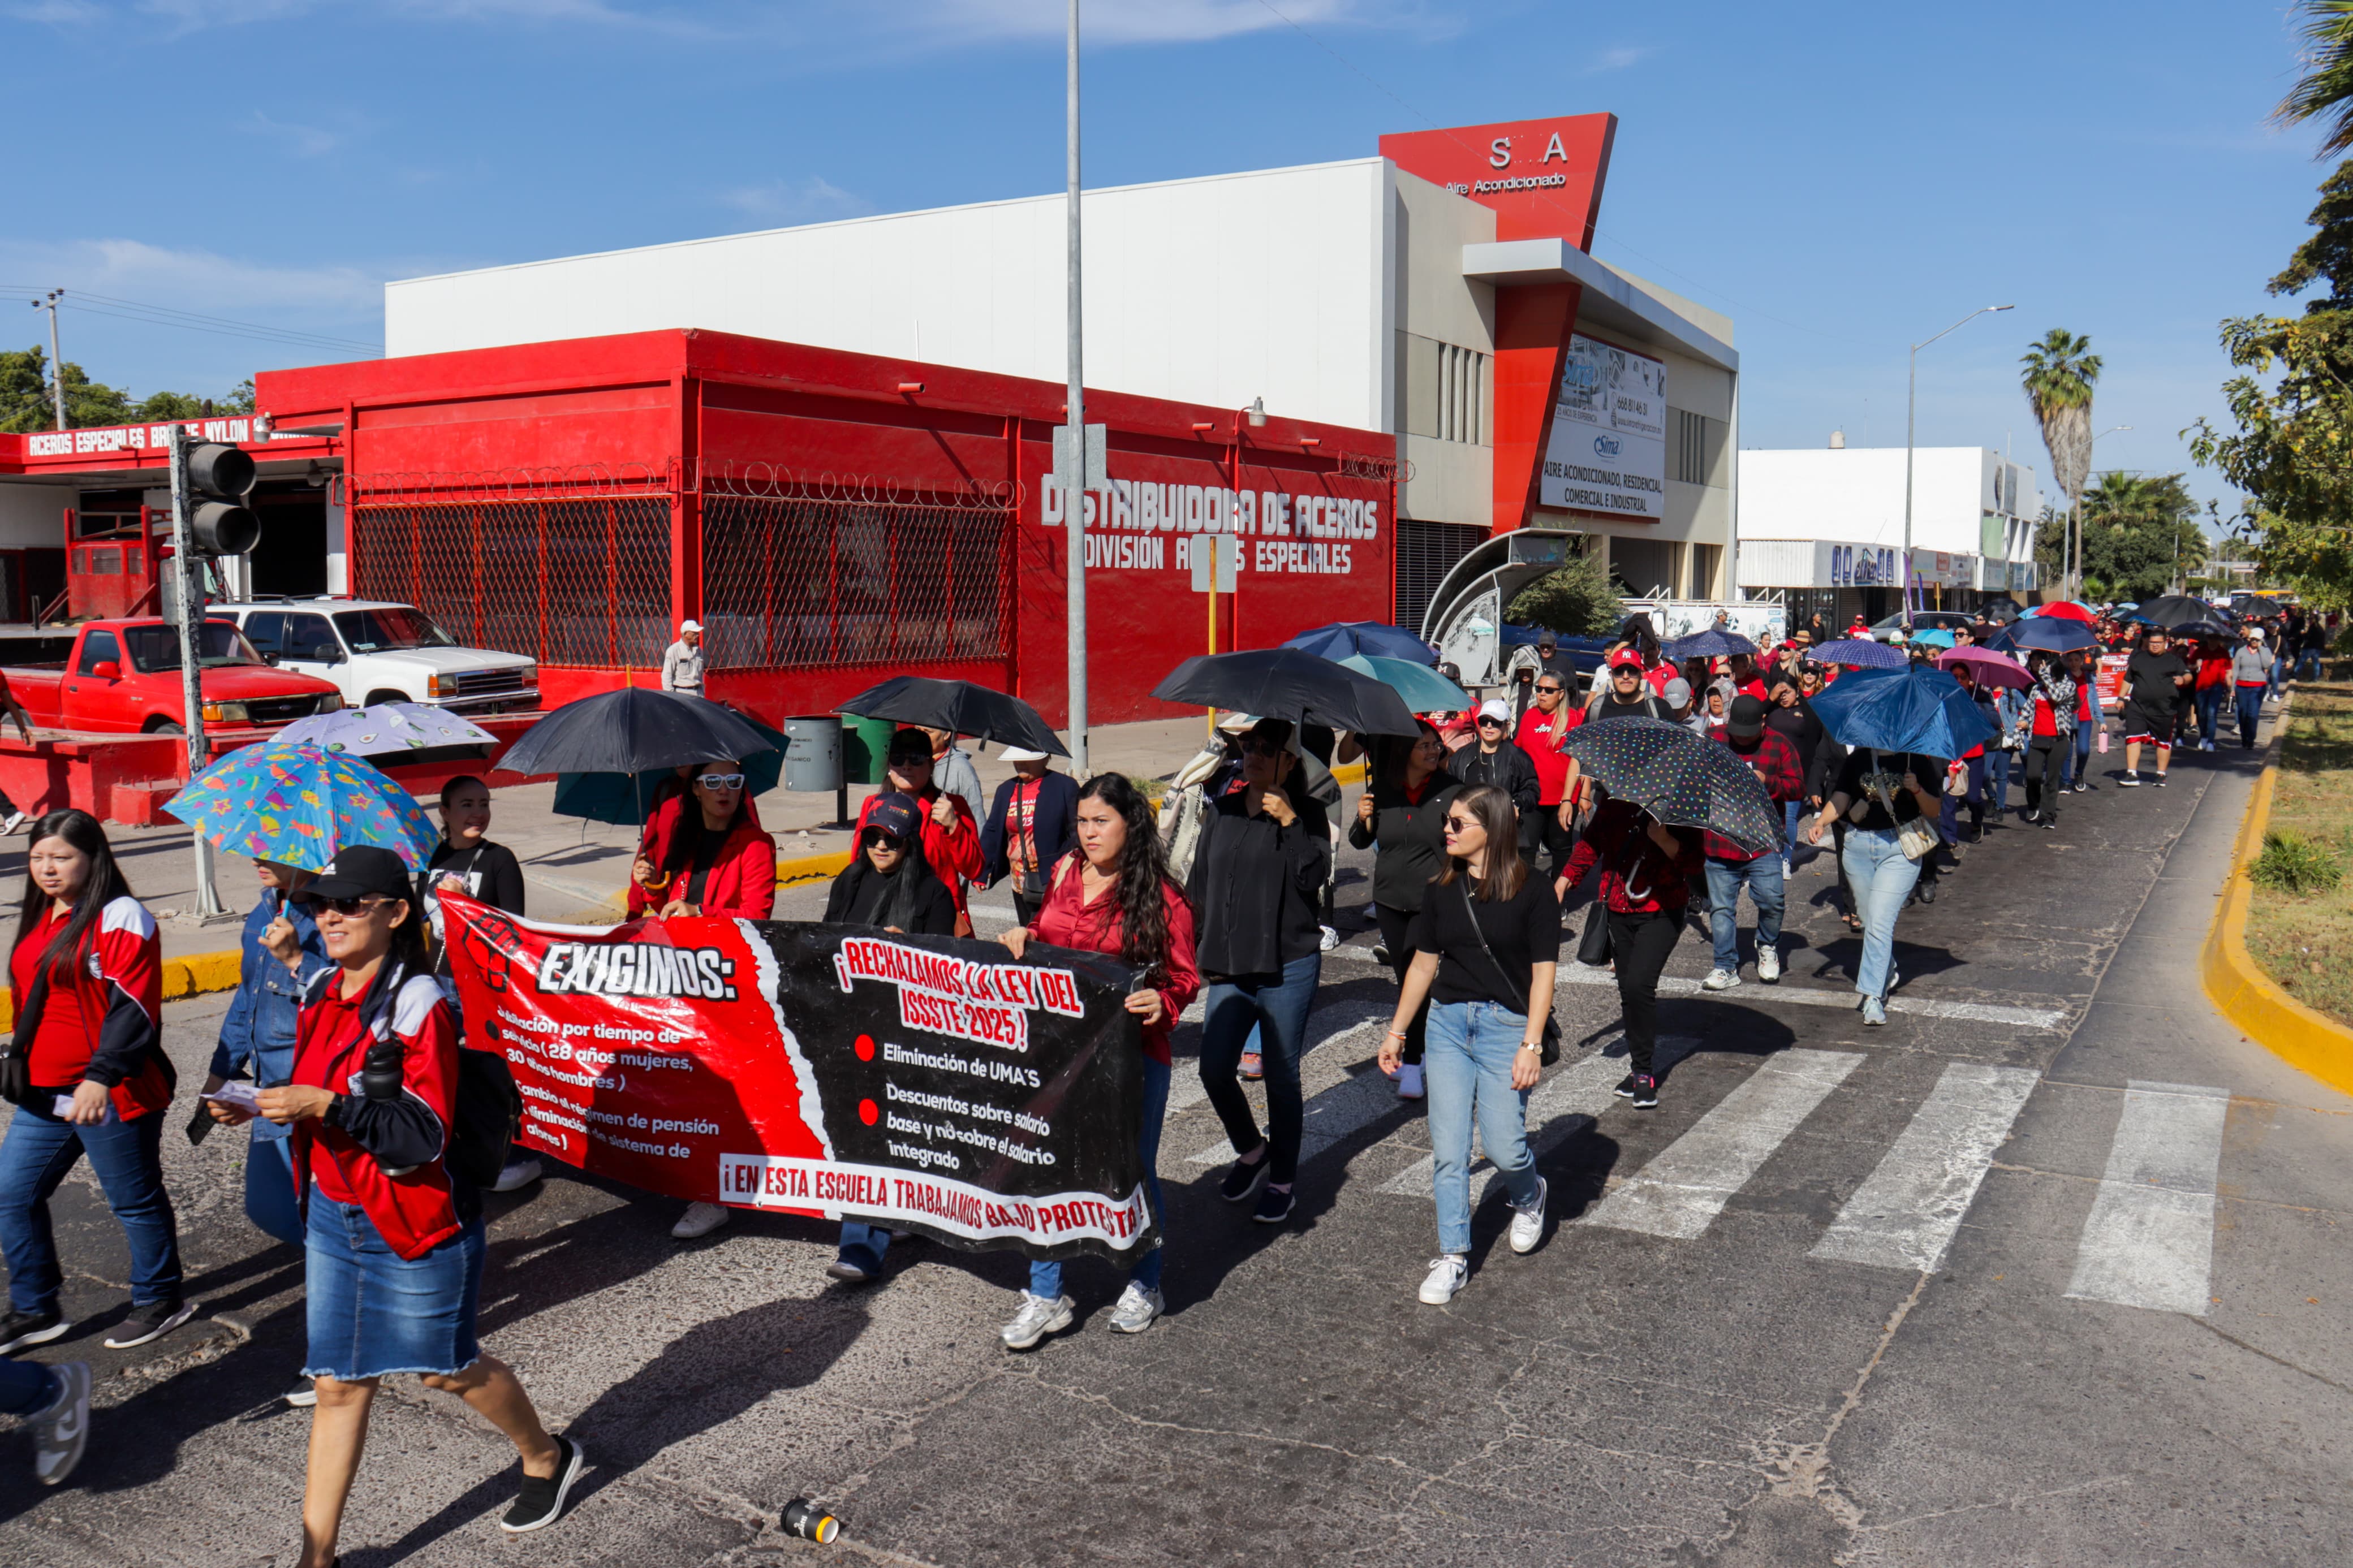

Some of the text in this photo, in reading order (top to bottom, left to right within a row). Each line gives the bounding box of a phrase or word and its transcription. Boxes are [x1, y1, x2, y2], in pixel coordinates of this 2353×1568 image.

[1489, 132, 1568, 169] S A
[1446, 172, 1566, 194] Aire Acondicionado
[29, 433, 72, 456] ACEROS
[75, 427, 145, 453] ESPECIALES
[204, 419, 249, 442] NYLON
[1598, 435, 1619, 455] Sima
[1544, 461, 1662, 496] AIRE ACONDICIONADO, RESIDENCIAL,
[1262, 491, 1290, 536] DE
[1295, 495, 1377, 540] ACEROS
[1565, 487, 1647, 512] COMERCIAL E INDUSTRIAL
[1084, 530, 1164, 569] DIVISIÓN
[1256, 541, 1351, 574] ESPECIALES
[538, 944, 736, 1000] EXIGIMOS:
[965, 965, 994, 1001] LA
[994, 969, 1035, 1005] LEY
[1040, 972, 1080, 1013] DEL
[902, 988, 964, 1034] ISSSTE
[502, 1029, 540, 1053] servicio
[575, 1047, 617, 1064] años
[620, 1052, 693, 1072] mujeres,
[562, 1022, 591, 1039] por
[593, 1023, 654, 1045] tiempo
[657, 1028, 680, 1044] de
[506, 1048, 525, 1065] 30
[527, 1055, 550, 1077] años
[884, 1043, 967, 1073] Eliminación
[970, 1058, 987, 1078] de
[515, 1079, 719, 1135] Cambio al régimen de pensión
[886, 1083, 1050, 1137] Descuentos sobre salario
[609, 1135, 665, 1156] sistema
[668, 1143, 691, 1159] de
[887, 1111, 921, 1134] base
[923, 1124, 932, 1141] y
[956, 1129, 996, 1151] sobre
[998, 1137, 1009, 1156] el
[1008, 1143, 1055, 1165] salario
[888, 1140, 960, 1170] integrado
[735, 1165, 759, 1194] EN
[765, 1167, 809, 1198] ESTA
[816, 1170, 887, 1207] ESCUELA
[894, 1179, 982, 1229] TRABAJAMOS
[985, 1200, 1036, 1232] BAJO
